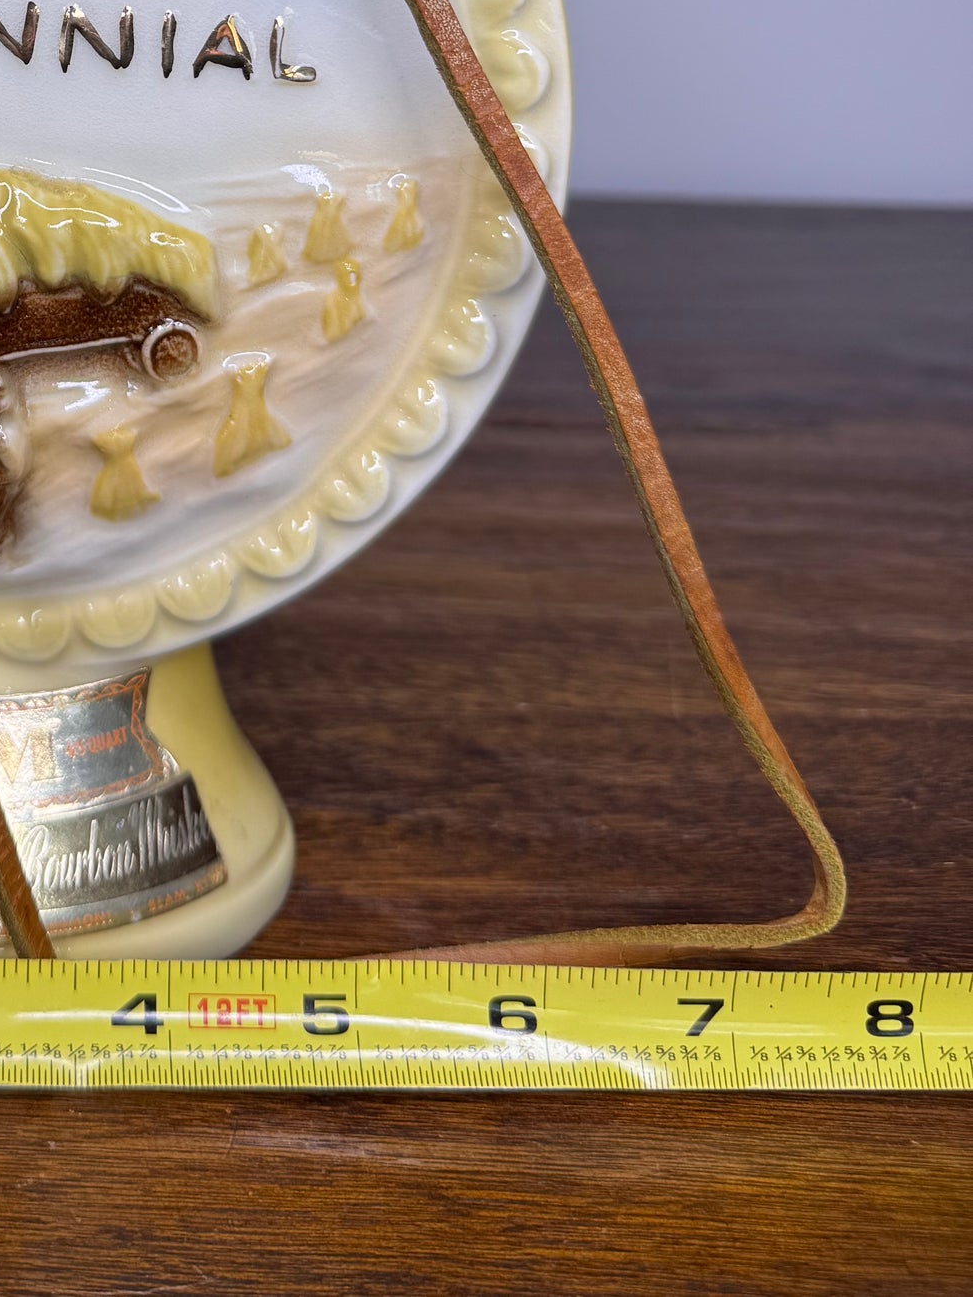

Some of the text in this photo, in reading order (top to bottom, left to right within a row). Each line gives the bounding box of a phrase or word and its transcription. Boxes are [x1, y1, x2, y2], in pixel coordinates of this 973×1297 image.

[87, 726, 127, 753] QUART
[21, 819, 137, 892] Bourbon
[111, 993, 164, 1035] 4
[302, 994, 349, 1035] 5
[488, 994, 537, 1035] 6
[677, 998, 724, 1037] 7
[865, 1000, 914, 1037] 8
[197, 997, 268, 1026] 12FT
[20, 1043, 37, 1058] 1/4
[42, 1043, 61, 1059] 3/8
[68, 1043, 86, 1059] 1/2
[91, 1043, 111, 1059] 5/8
[116, 1043, 134, 1059] 3/4
[137, 1043, 157, 1059] 7/8
[186, 1044, 204, 1059] 1/8
[211, 1044, 229, 1059] 1/4
[232, 1044, 252, 1059] 3/8
[257, 1044, 276, 1059] 1/2
[280, 1044, 301, 1059] 5/8
[305, 1044, 324, 1059] 3/4
[328, 1044, 347, 1059] 7/8
[374, 1044, 393, 1059] 1/8
[400, 1045, 417, 1060] 1/4
[445, 1045, 464, 1060] 1/2
[609, 1045, 628, 1061] 3/8
[633, 1045, 652, 1061] 1/2
[656, 1045, 676, 1061] 5/8
[680, 1045, 698, 1061] 3/4
[703, 1045, 721, 1061] 7/8
[749, 1046, 769, 1061] 1/8
[774, 1046, 792, 1061] 1/4
[796, 1046, 816, 1062] 3/8
[821, 1046, 840, 1062] 1/2
[844, 1046, 865, 1062] 5/8
[869, 1046, 888, 1062] 3/4
[892, 1046, 911, 1062] 7/8
[938, 1046, 957, 1062] 1/8
